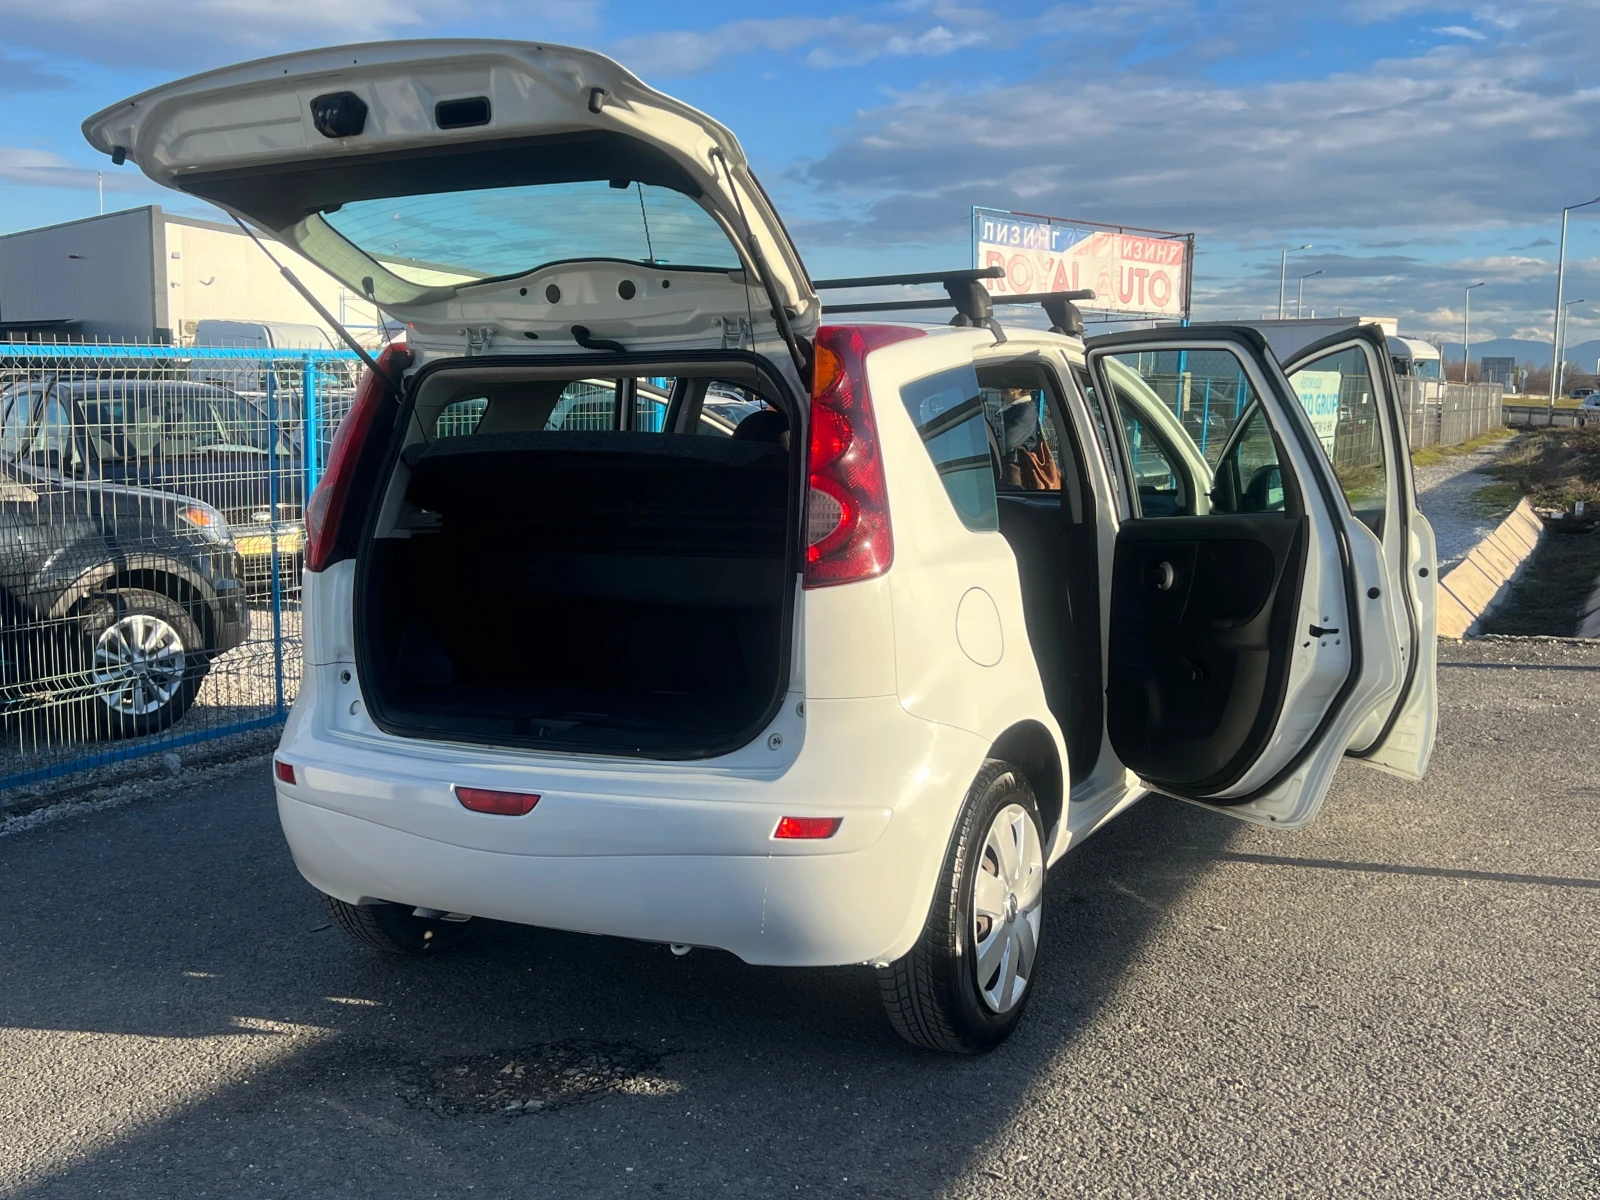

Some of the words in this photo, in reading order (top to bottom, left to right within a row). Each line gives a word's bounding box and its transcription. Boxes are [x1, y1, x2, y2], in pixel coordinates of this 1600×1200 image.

[982, 220, 1061, 249] ЛИЗИНГ
[1115, 239, 1181, 264] ИЗИНГ
[1095, 264, 1172, 308] AUTO
